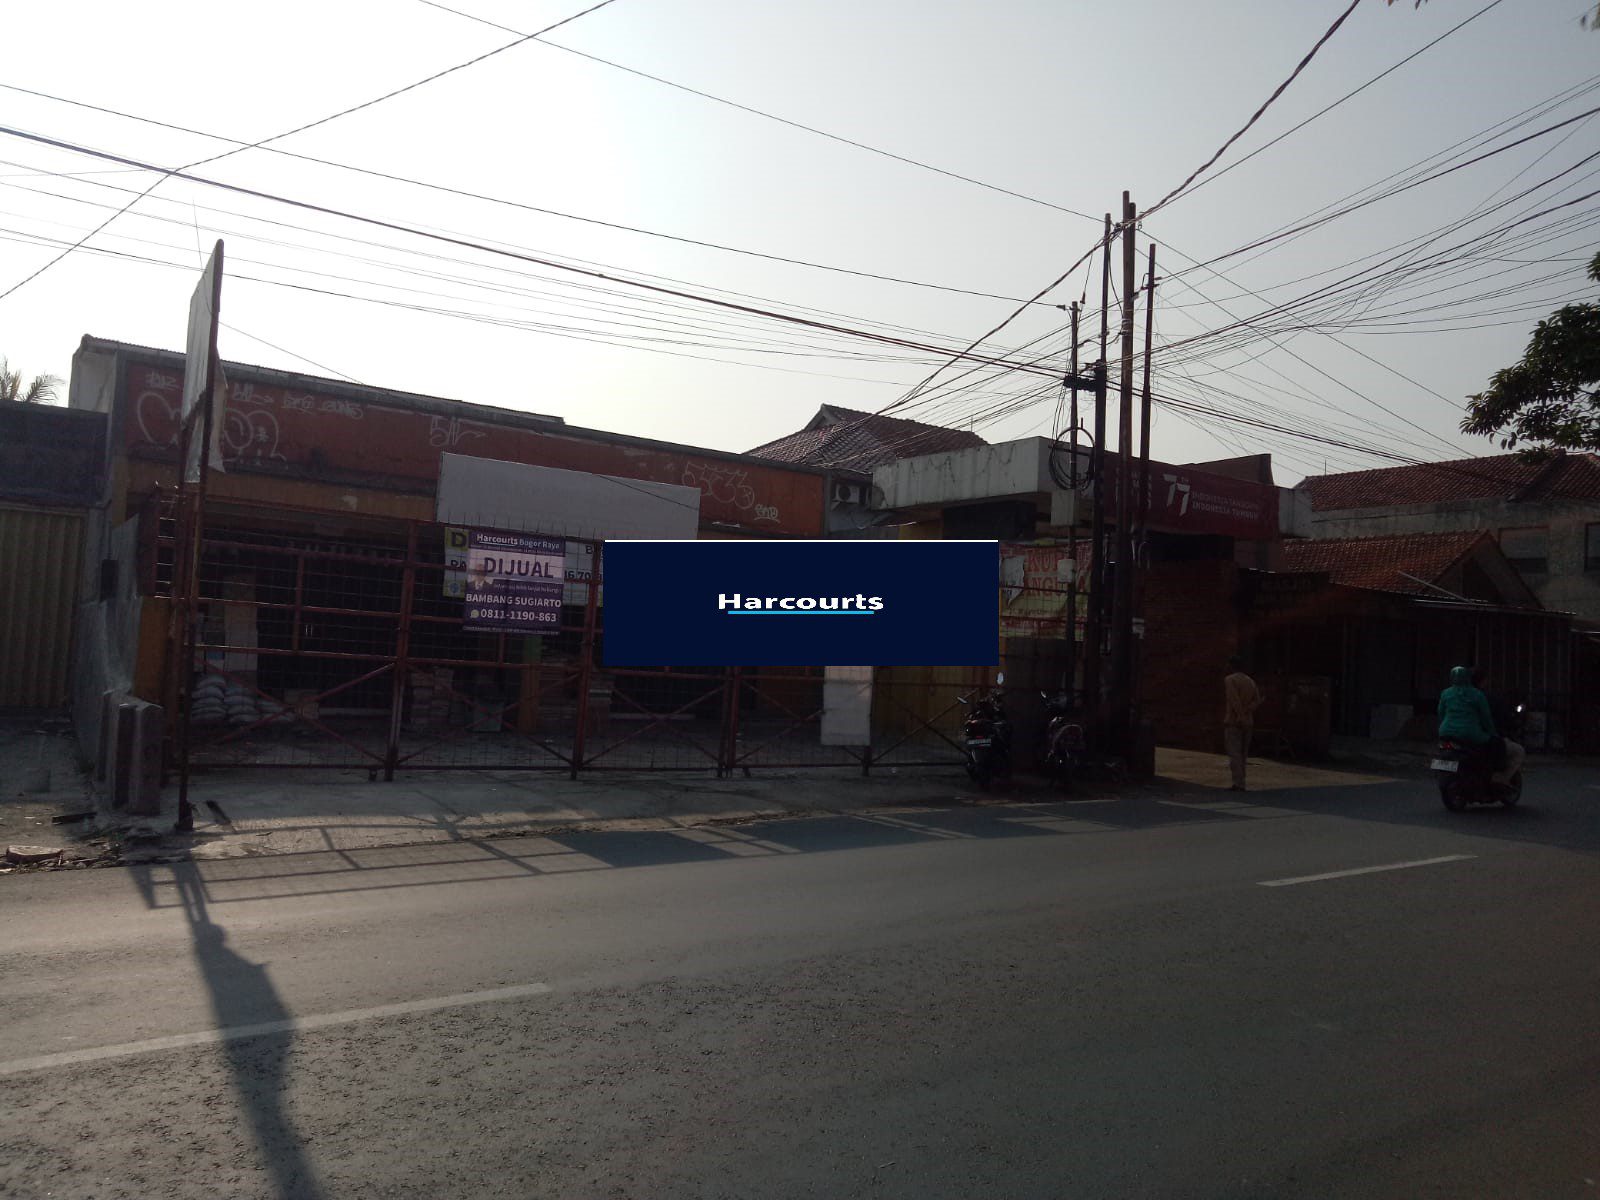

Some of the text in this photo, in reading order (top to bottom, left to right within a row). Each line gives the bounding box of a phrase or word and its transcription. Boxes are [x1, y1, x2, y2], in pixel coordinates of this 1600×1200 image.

[476, 533, 518, 546] Harcourts
[519, 538, 542, 549] Bogor
[542, 541, 560, 551] Raya
[484, 557, 554, 579] DIJUAL
[465, 593, 562, 608] BAMBANG SUGIARTO
[480, 609, 557, 623] 0811-1190-863
